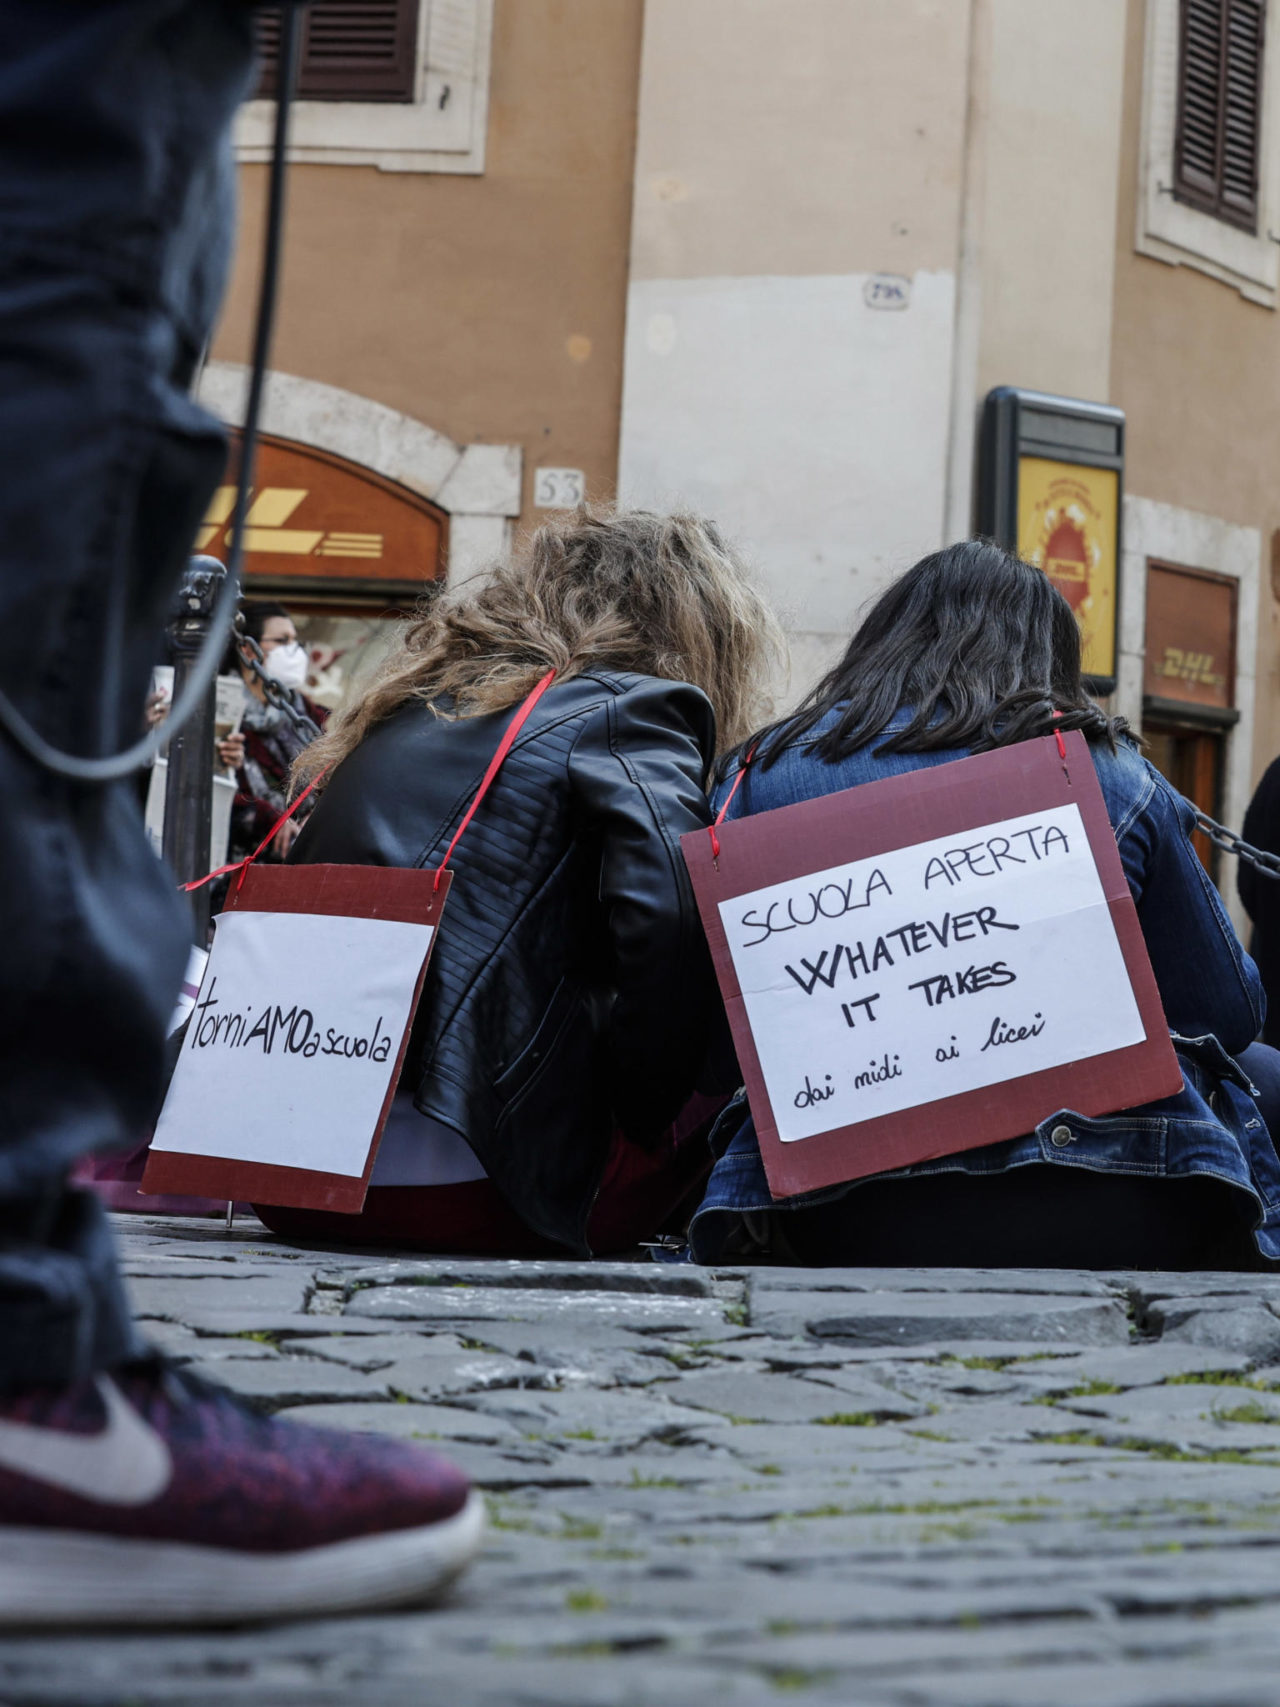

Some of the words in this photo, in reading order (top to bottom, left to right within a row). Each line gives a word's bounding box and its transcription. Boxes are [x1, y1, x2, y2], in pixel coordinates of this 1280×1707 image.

[539, 472, 580, 504] 53
[1163, 647, 1218, 685] DHL
[742, 869, 893, 947] SCUOLA
[924, 826, 1070, 891] APERTA
[785, 906, 1019, 995] WHATEVER
[841, 994, 881, 1027] IT
[909, 962, 1017, 1006] TAKES
[794, 1075, 835, 1108] dai
[935, 1036, 961, 1062] ai
[980, 1012, 1046, 1052] licei
